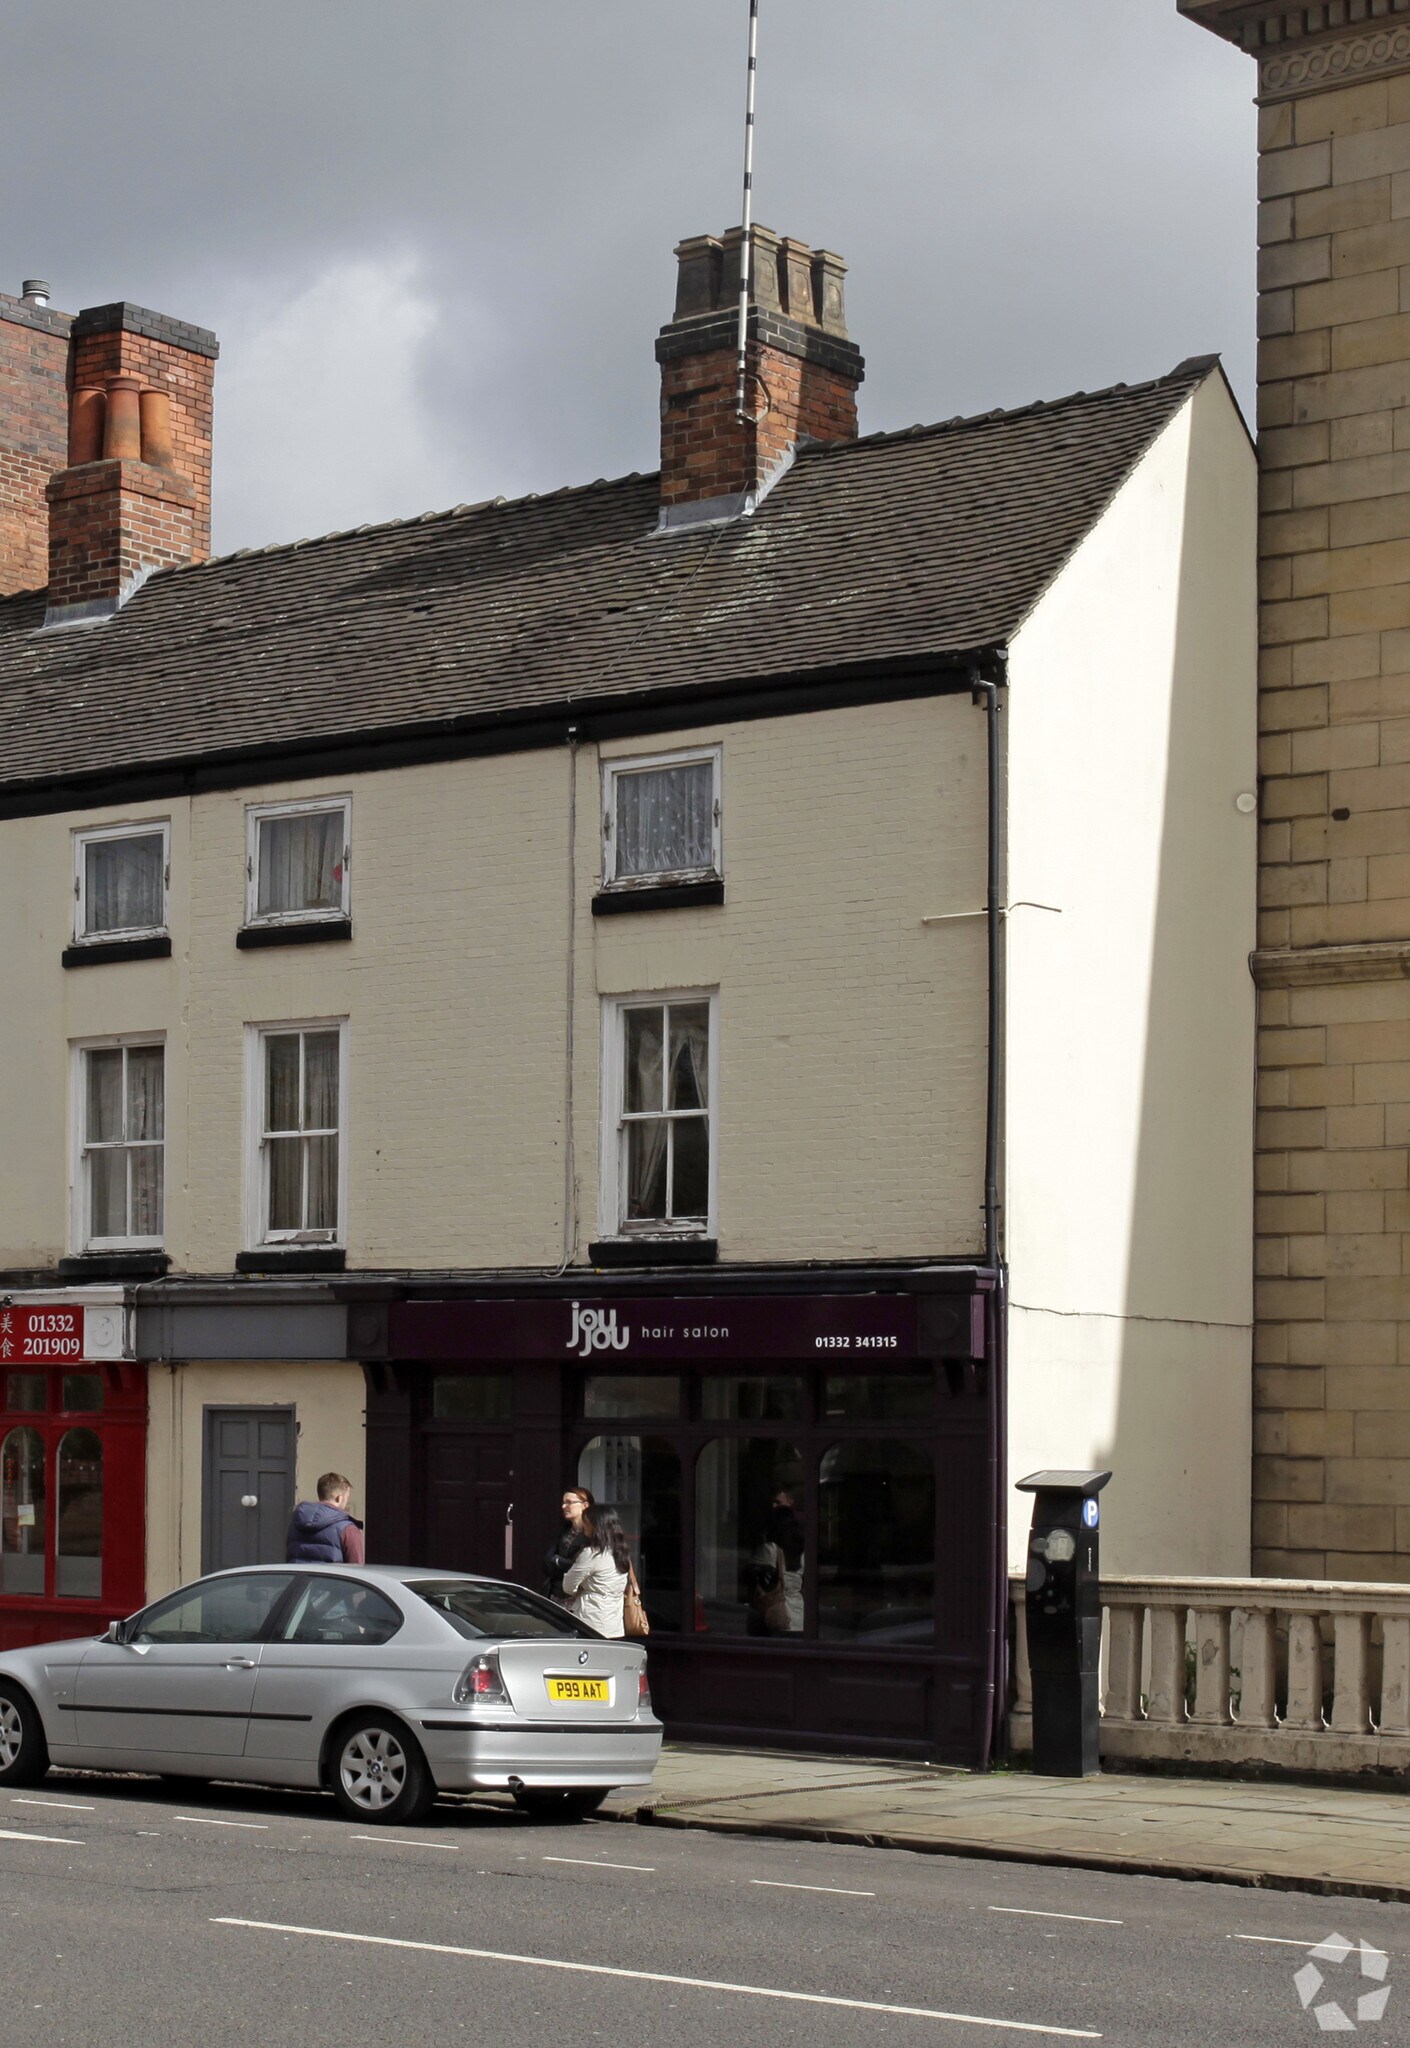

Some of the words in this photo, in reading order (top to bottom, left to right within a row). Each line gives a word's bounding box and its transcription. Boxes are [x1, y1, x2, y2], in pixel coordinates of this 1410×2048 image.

[28, 1314, 75, 1333] 01332
[641, 1326, 674, 1339] hair
[683, 1325, 730, 1339] salon
[23, 1337, 81, 1356] 201909
[814, 1336, 851, 1348] 01332
[854, 1335, 898, 1348] 341315
[1087, 1500, 1098, 1526] P
[556, 1681, 580, 1698] P99
[583, 1682, 602, 1699] AAT
